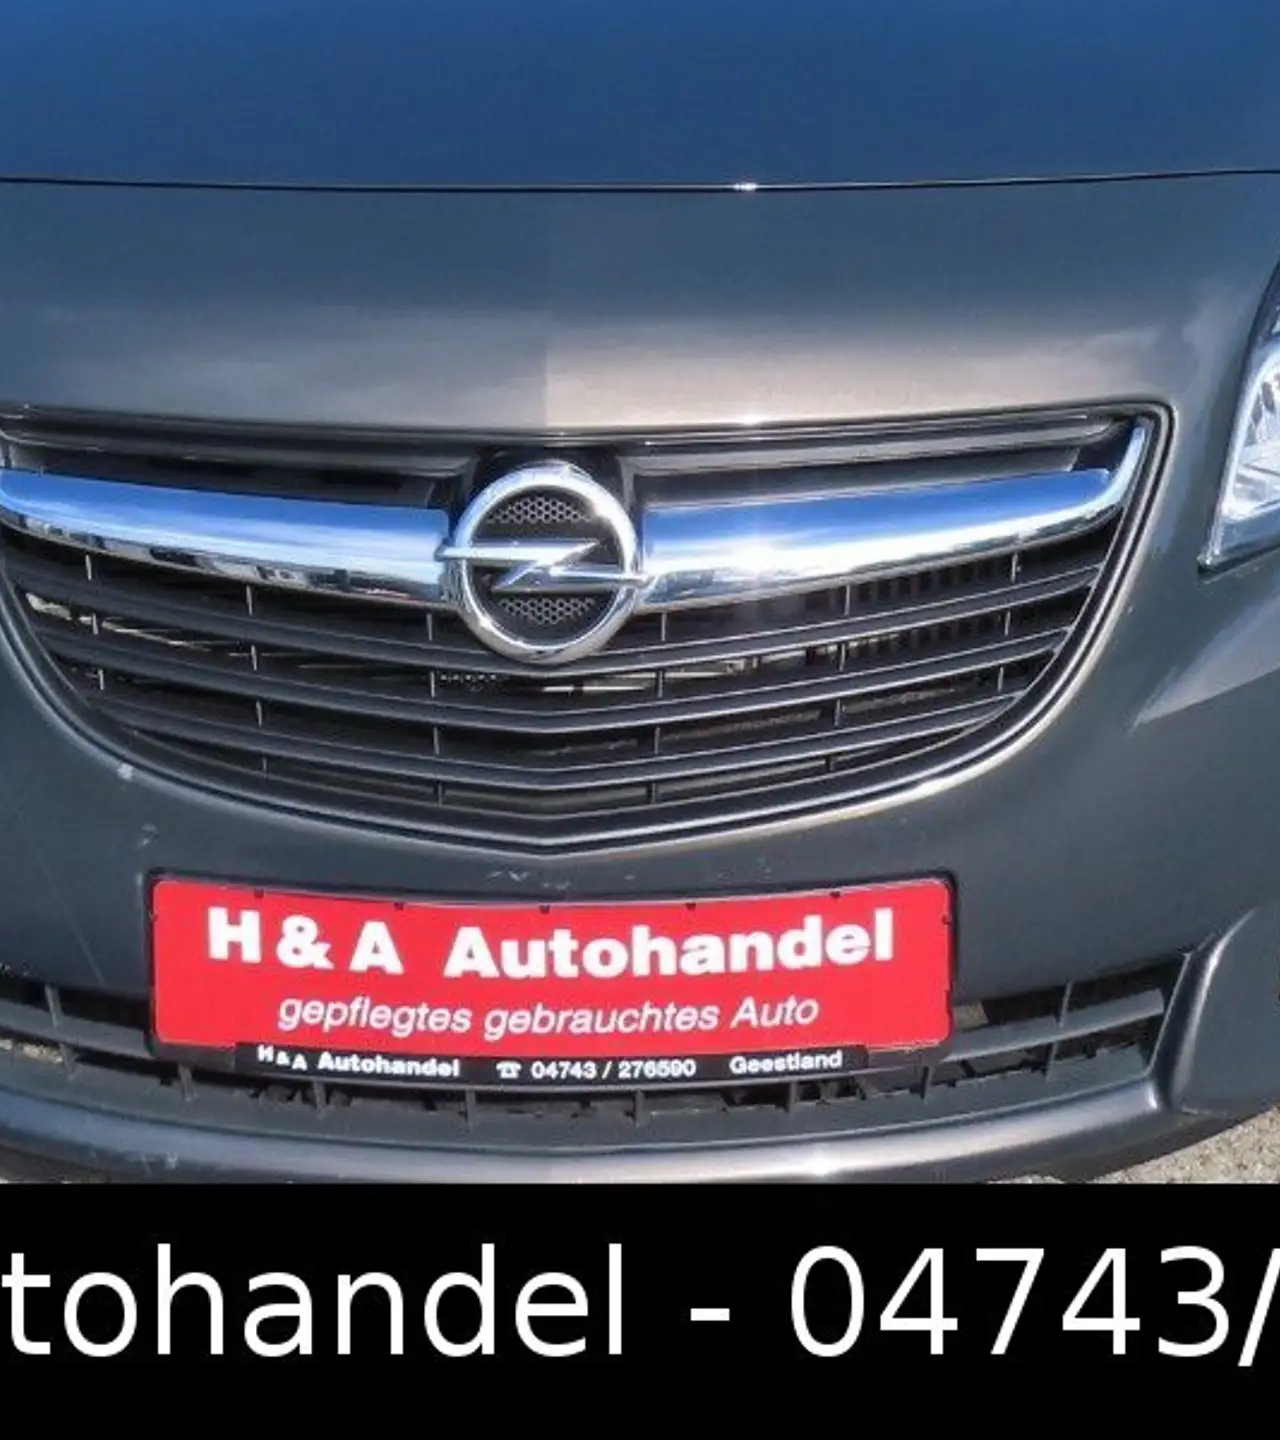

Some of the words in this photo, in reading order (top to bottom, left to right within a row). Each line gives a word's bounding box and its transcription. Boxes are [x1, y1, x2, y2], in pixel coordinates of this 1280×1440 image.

[443, 907, 894, 979] Autohandel
[278, 996, 472, 1038] gepflegtes
[483, 999, 720, 1041] gebrauchtes
[730, 995, 820, 1030] Auto
[317, 1051, 461, 1078] Autohandel
[530, 1060, 597, 1080] 04743
[618, 1059, 697, 1079] 276590
[729, 1050, 843, 1076] Geestland
